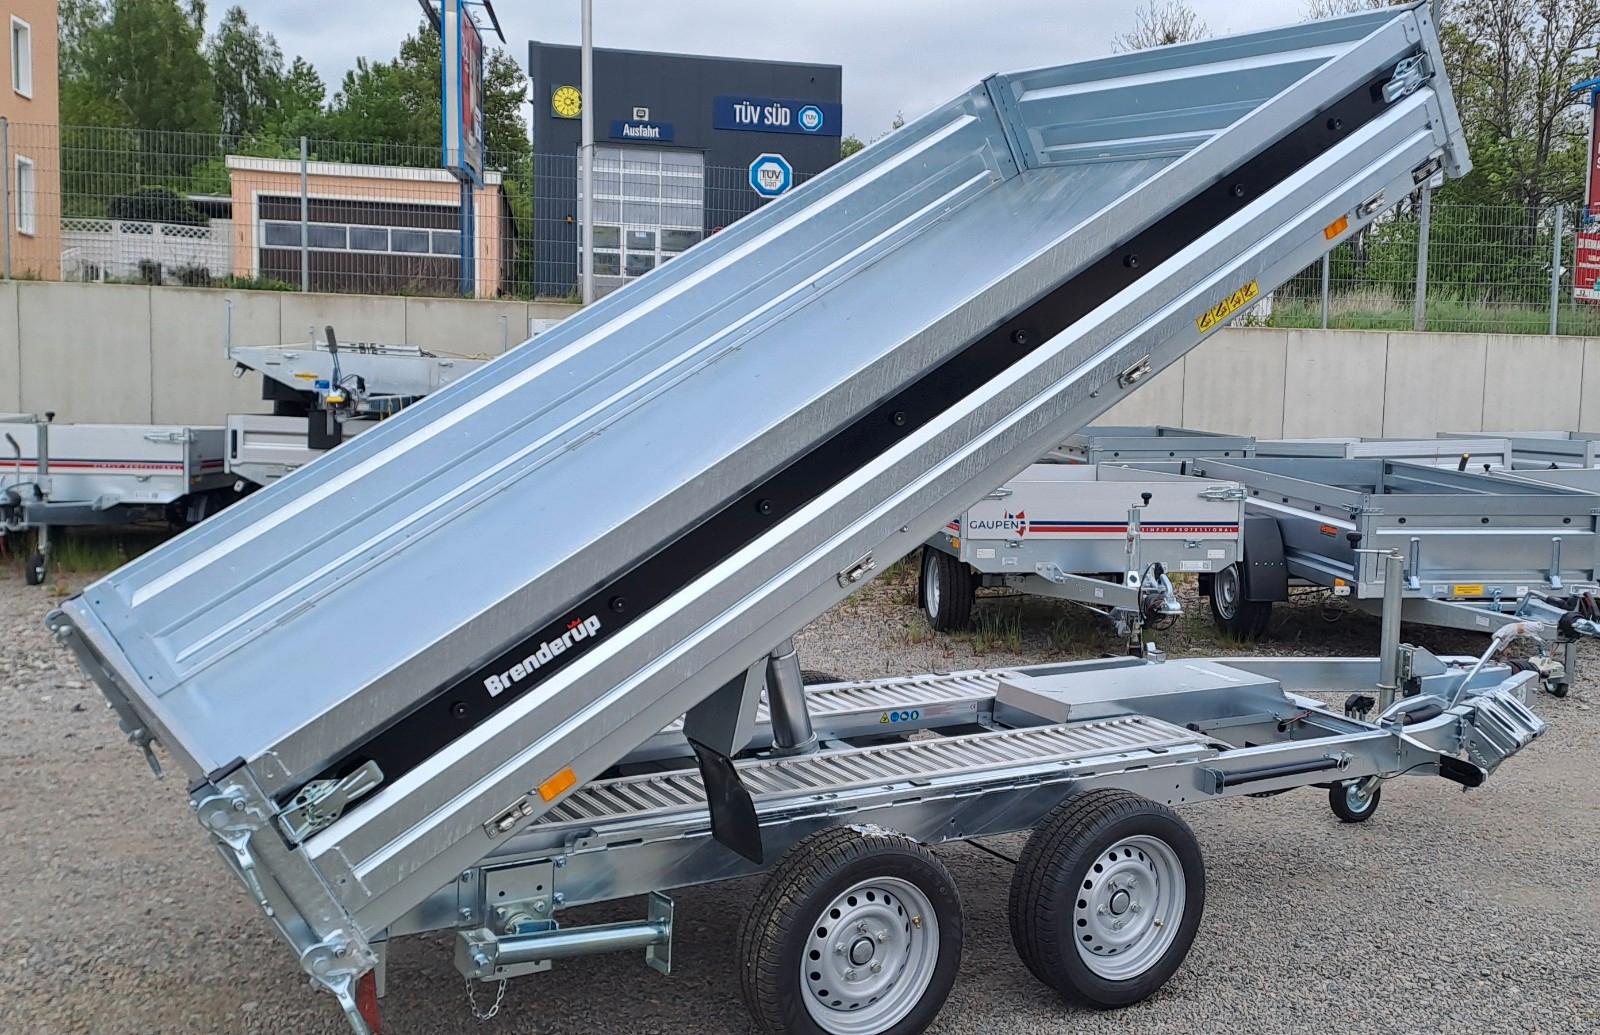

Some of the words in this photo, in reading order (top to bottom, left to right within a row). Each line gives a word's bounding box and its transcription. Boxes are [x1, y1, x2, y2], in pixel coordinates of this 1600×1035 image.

[733, 101, 760, 124] TÜV
[764, 103, 791, 126] SÜD
[622, 123, 660, 138] Ausfahrt
[969, 520, 1019, 530] GAUPEN
[483, 614, 601, 698] Brenderup
